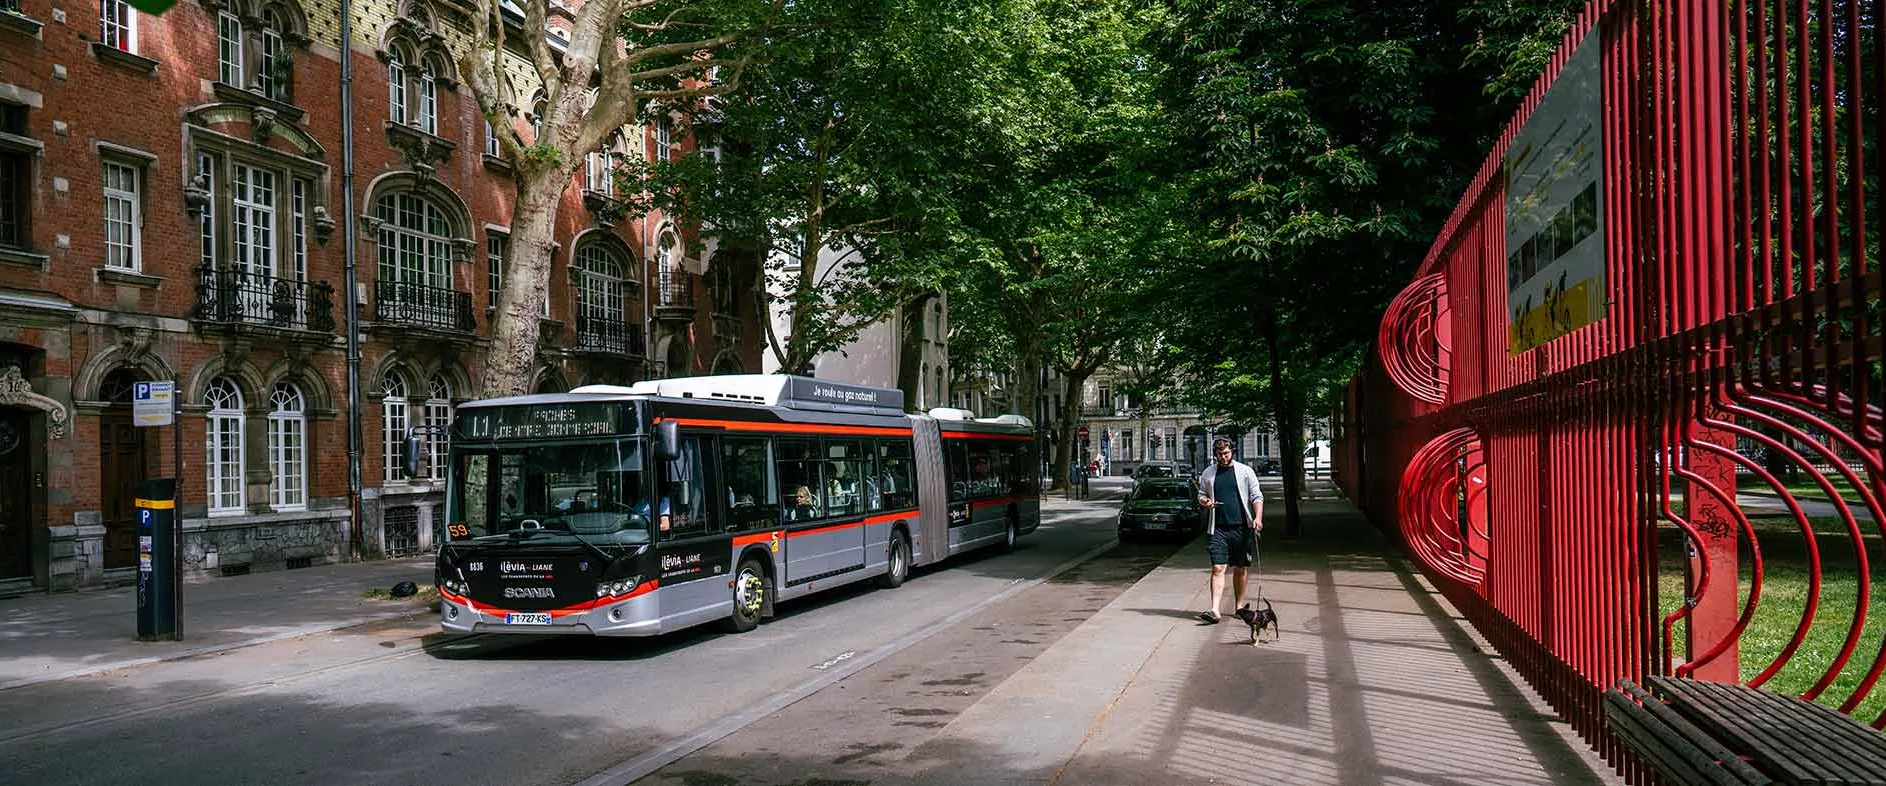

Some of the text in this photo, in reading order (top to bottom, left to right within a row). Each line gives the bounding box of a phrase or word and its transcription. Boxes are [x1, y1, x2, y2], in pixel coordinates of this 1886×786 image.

[138, 384, 148, 398] P
[814, 385, 821, 396] Je
[822, 387, 836, 398] roule
[845, 391, 855, 402] gaz
[855, 391, 874, 401] naturel
[142, 510, 150, 524] P
[448, 524, 468, 537] 59
[504, 587, 555, 599] SCANIA
